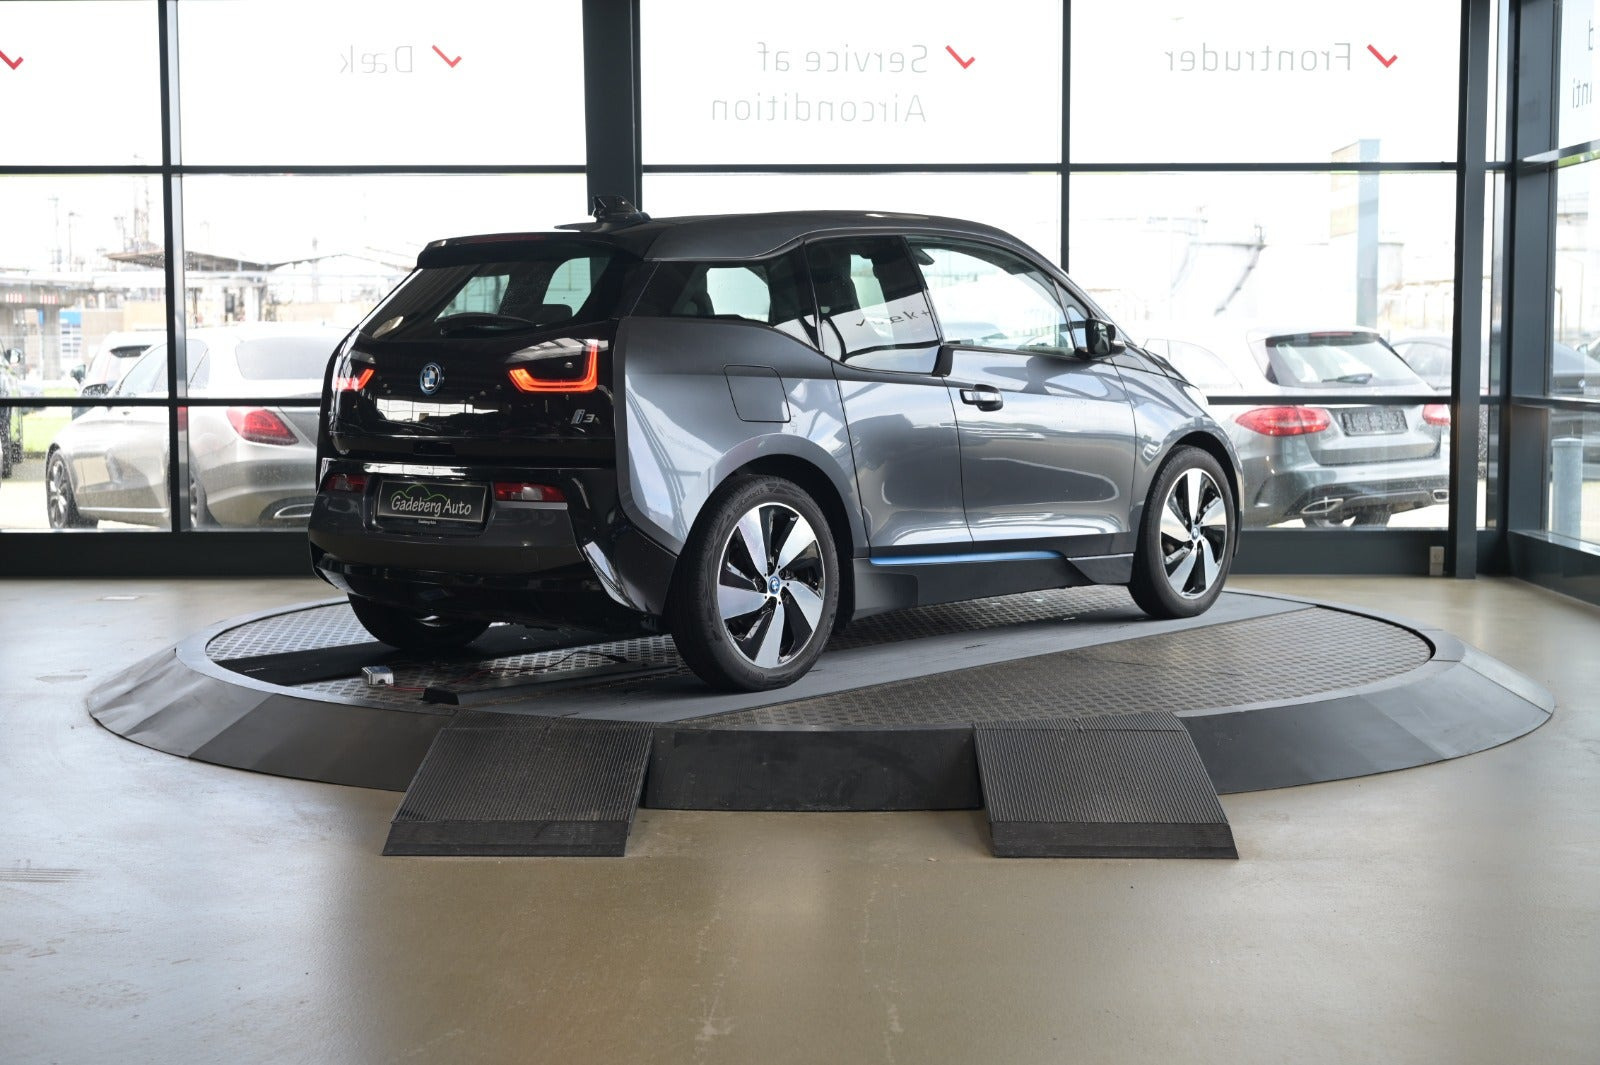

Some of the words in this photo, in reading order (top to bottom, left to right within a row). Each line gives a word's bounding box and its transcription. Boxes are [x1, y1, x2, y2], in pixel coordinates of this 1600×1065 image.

[570, 408, 596, 425] i3
[391, 495, 442, 518] Gadeberg
[443, 498, 472, 516] Auto
